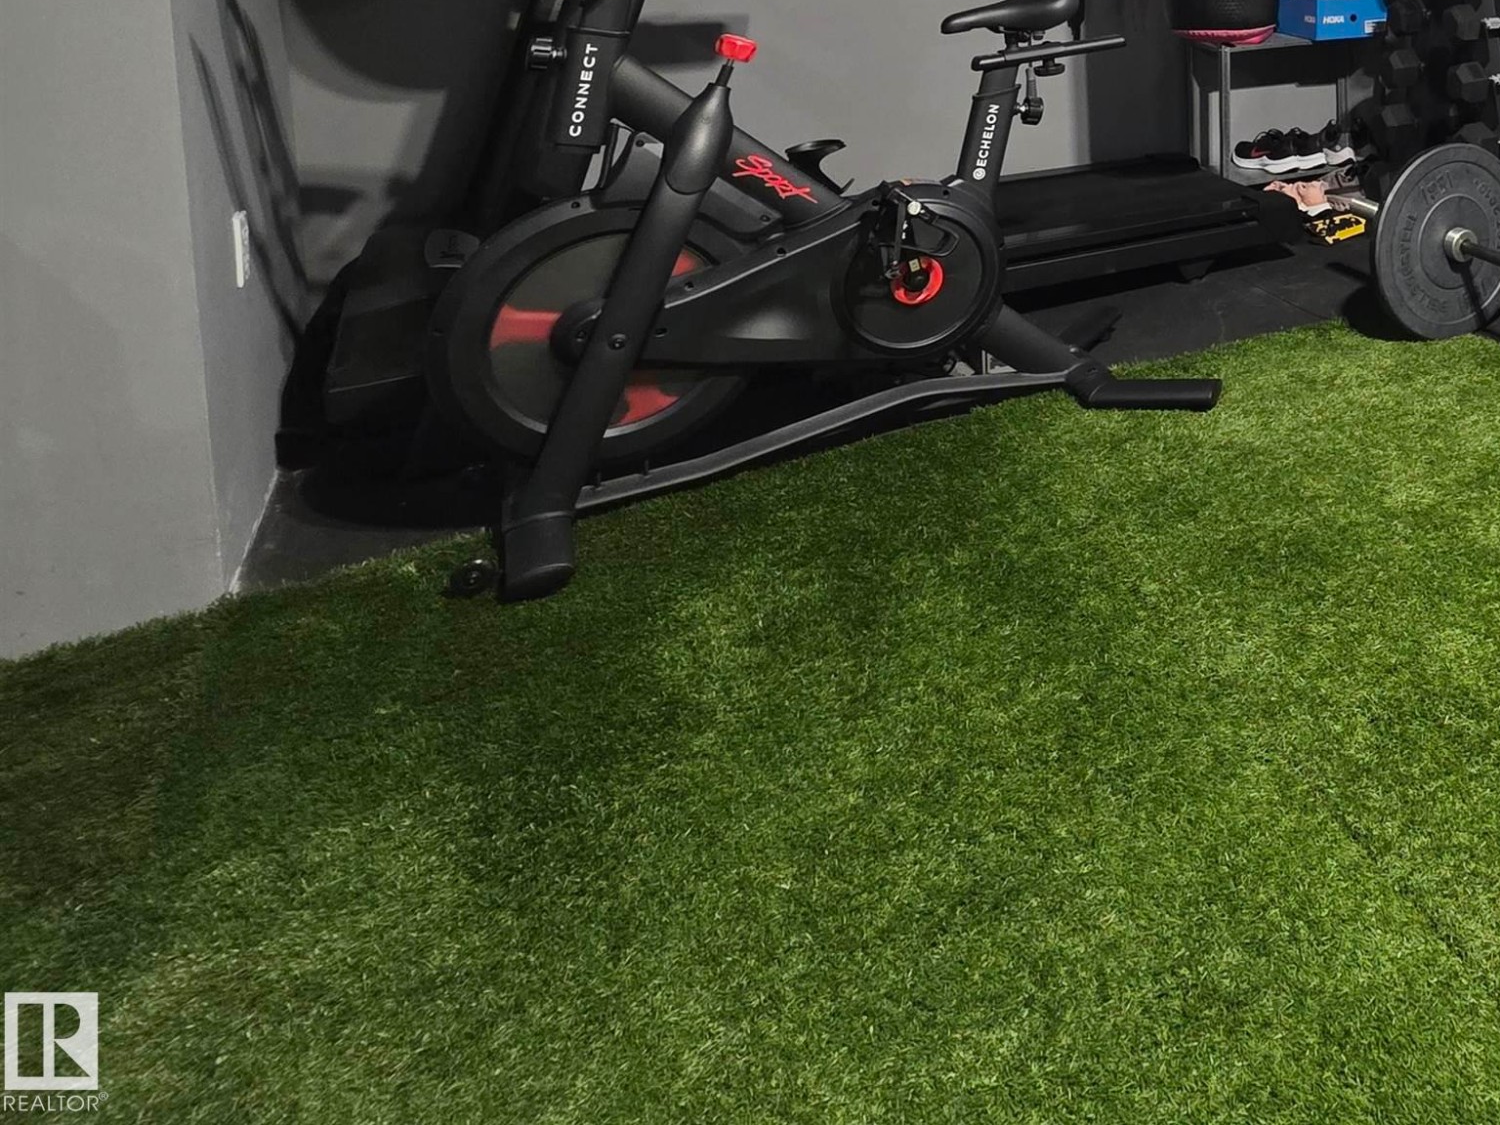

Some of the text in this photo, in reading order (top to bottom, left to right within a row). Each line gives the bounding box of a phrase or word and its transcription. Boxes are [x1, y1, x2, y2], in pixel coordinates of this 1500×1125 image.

[1323, 15, 1345, 24] HOKA
[569, 42, 599, 137] CONNECT
[976, 104, 1000, 167] ECHELON
